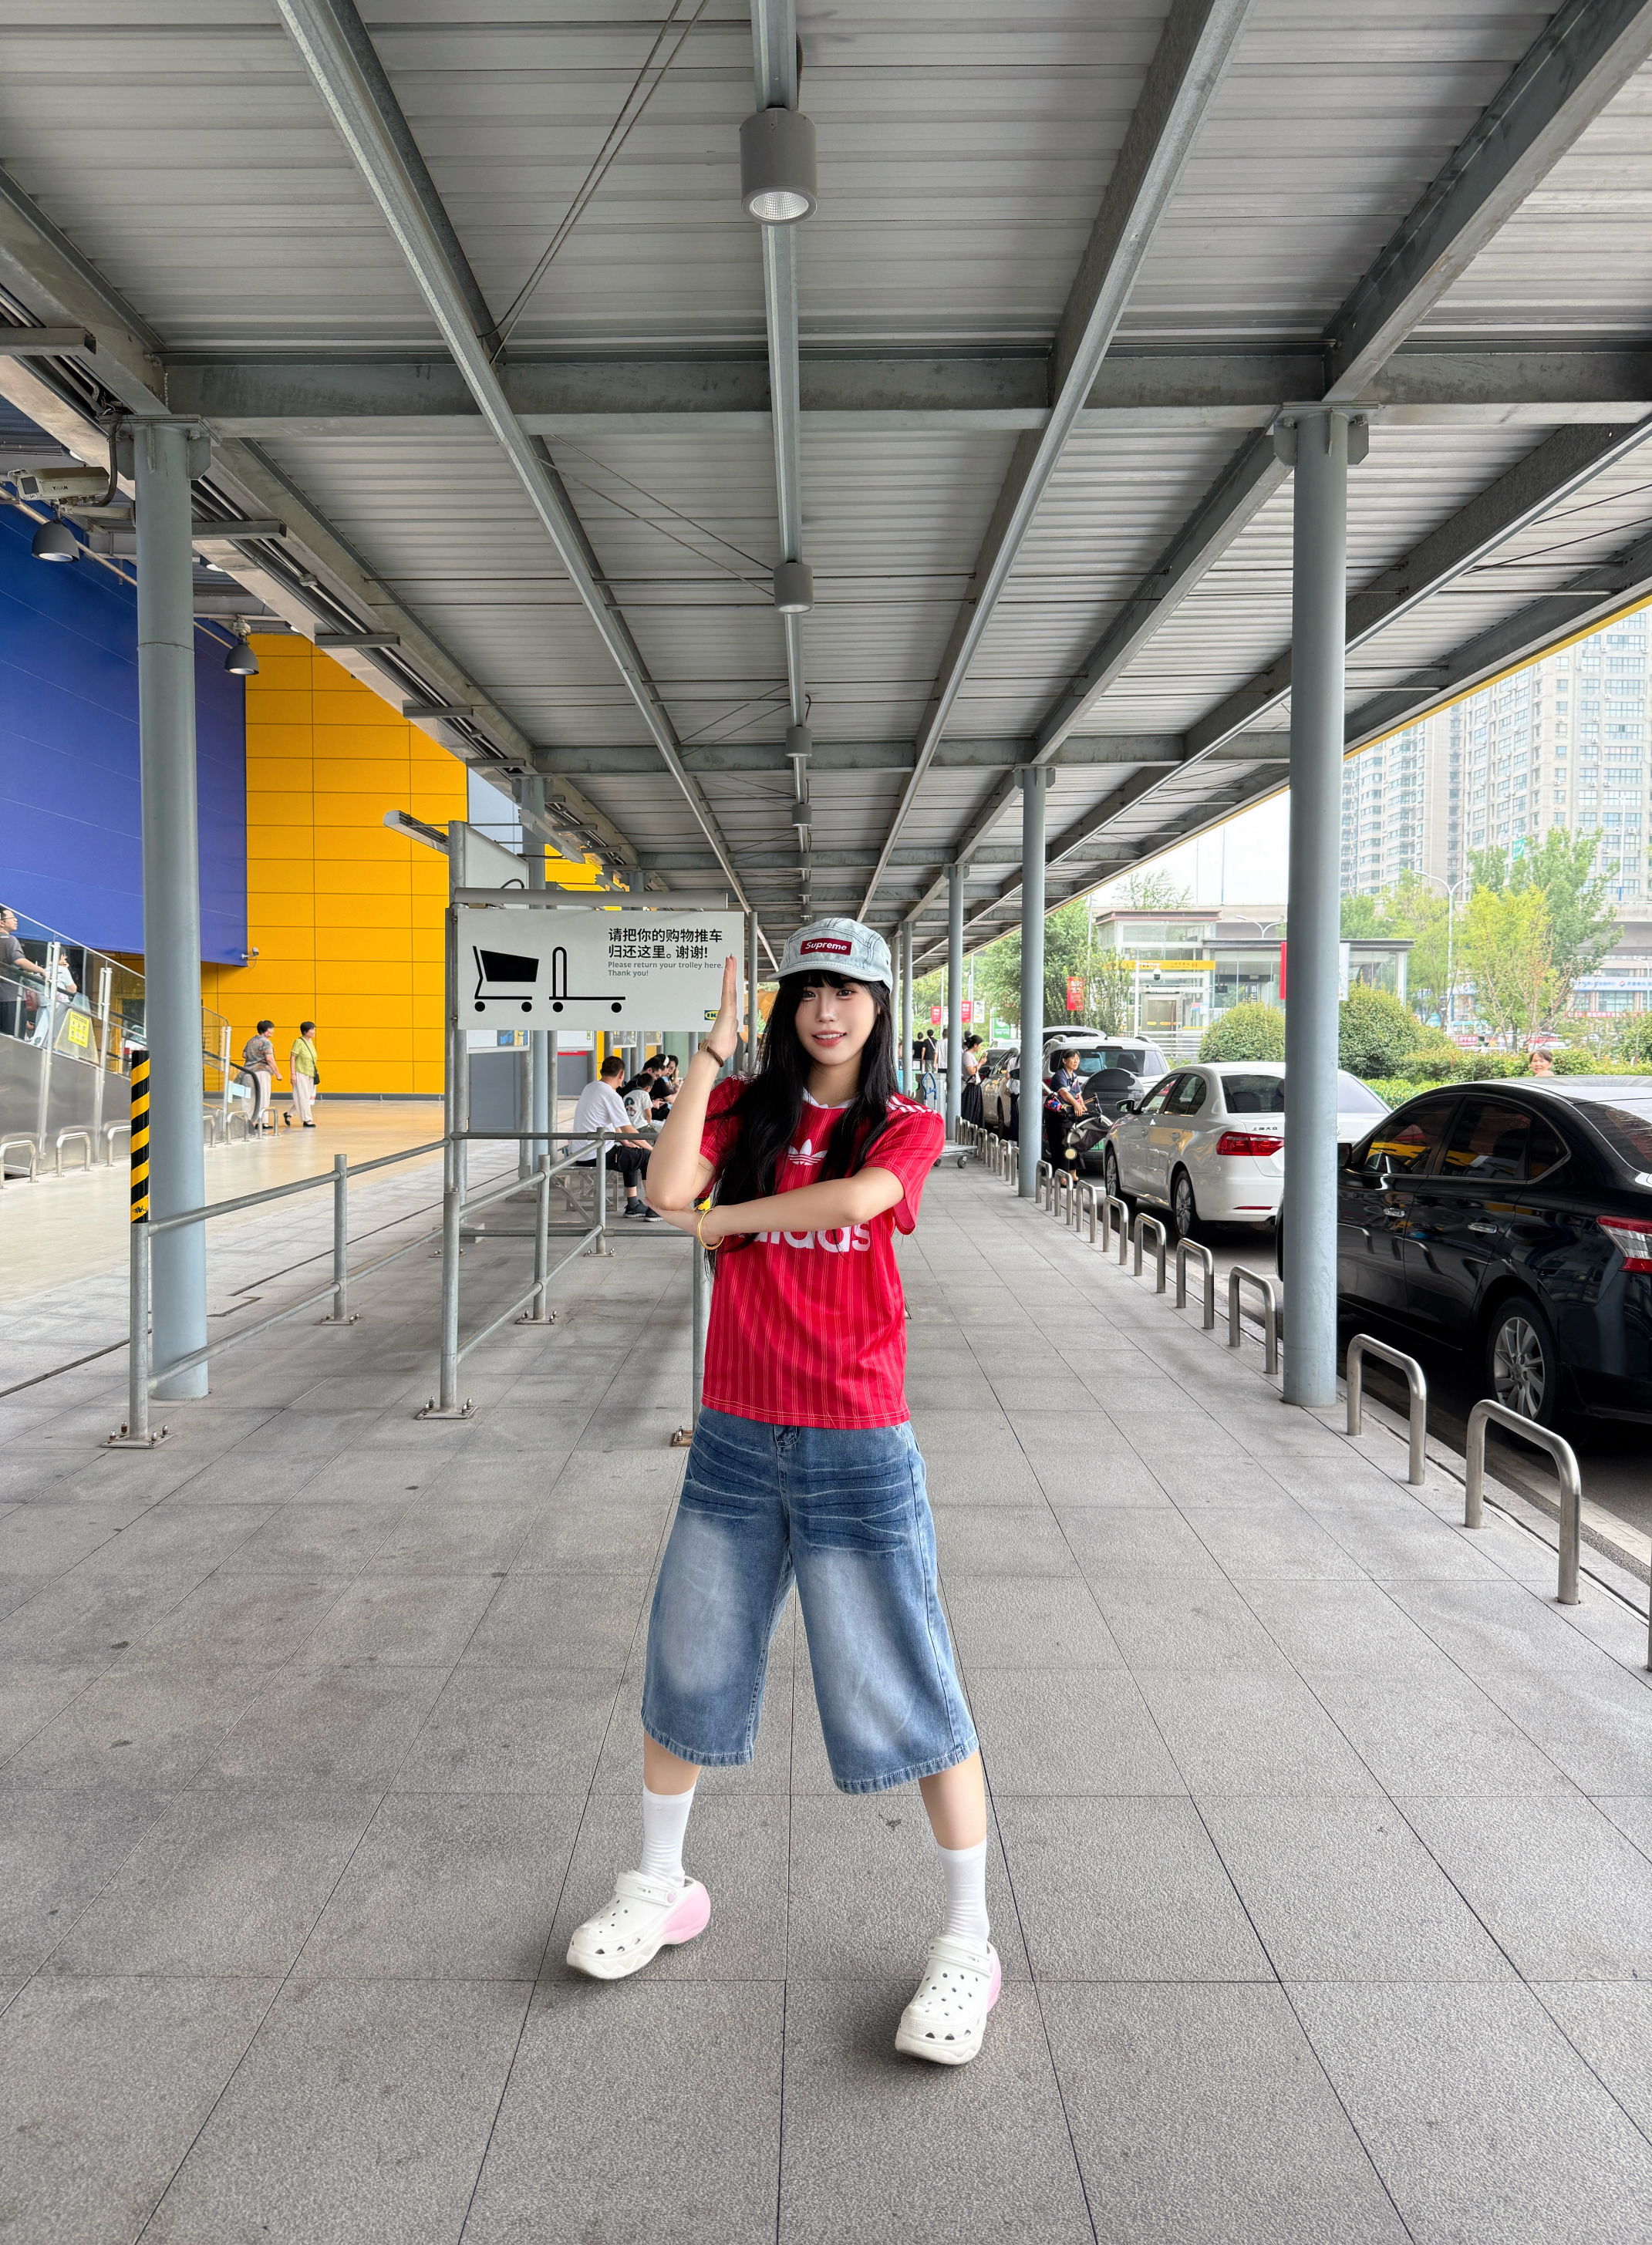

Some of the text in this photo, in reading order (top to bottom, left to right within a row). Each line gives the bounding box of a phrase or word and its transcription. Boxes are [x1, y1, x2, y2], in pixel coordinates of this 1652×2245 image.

[608, 928, 723, 943] 请把你的购物推车
[804, 942, 848, 950] Supreme
[678, 962, 703, 970] trolley
[632, 969, 649, 978] you!
